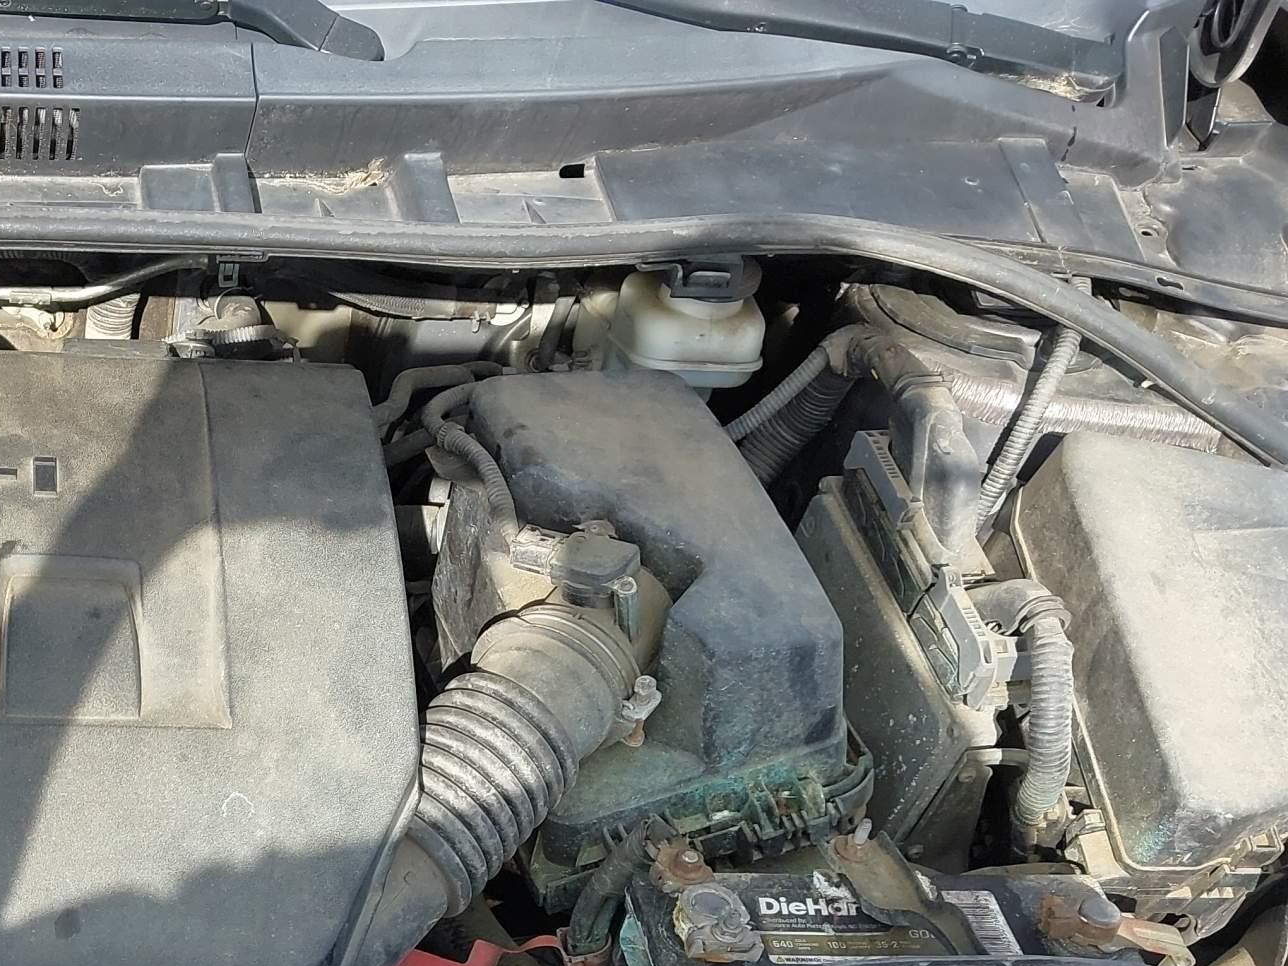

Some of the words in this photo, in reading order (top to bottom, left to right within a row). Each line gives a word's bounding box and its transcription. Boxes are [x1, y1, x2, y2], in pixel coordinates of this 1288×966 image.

[758, 896, 860, 917] DieHar
[909, 928, 935, 939] GO
[772, 940, 794, 948] 640
